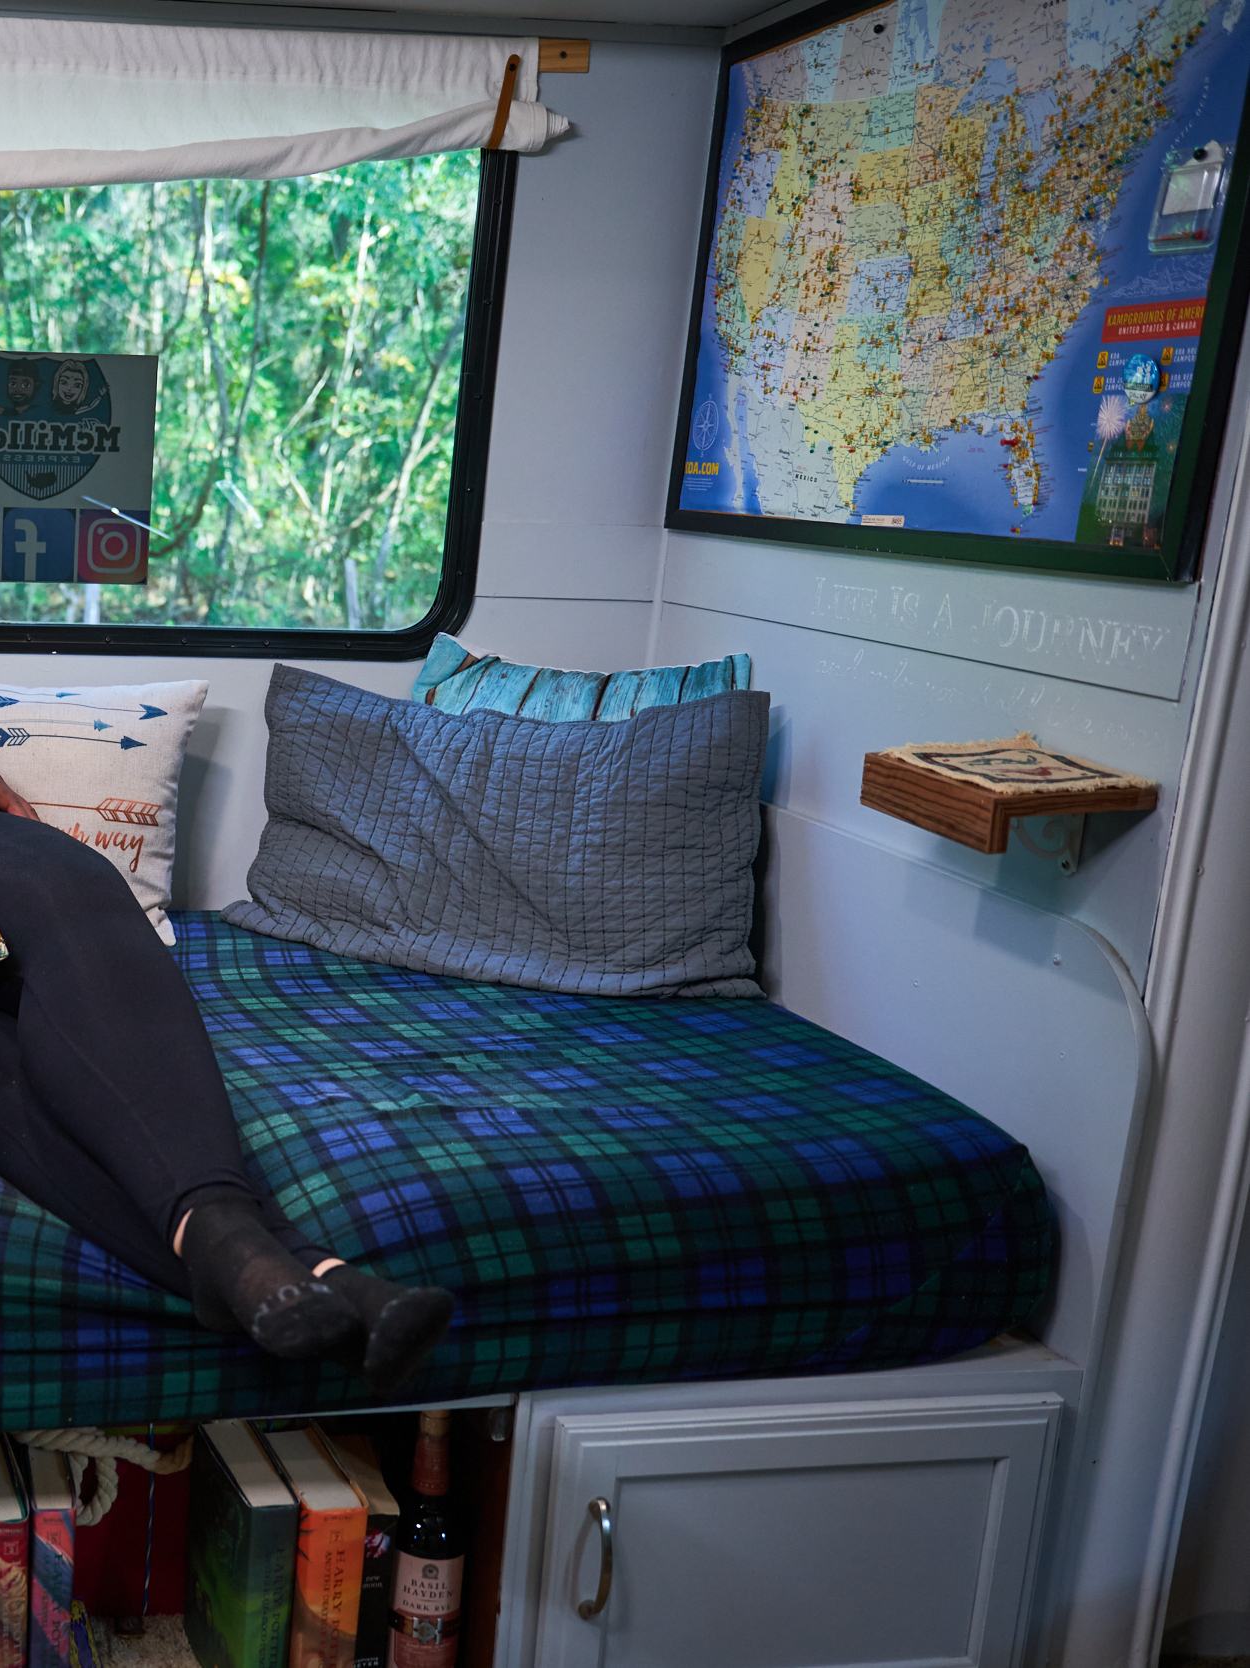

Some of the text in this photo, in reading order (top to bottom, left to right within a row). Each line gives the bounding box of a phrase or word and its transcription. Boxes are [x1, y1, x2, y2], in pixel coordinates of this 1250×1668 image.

[1107, 309, 1165, 327] KAMPGROUNDS
[1167, 308, 1177, 321] OF
[1118, 320, 1197, 335] UNITED STATES & CANADA
[684, 461, 720, 475] KOA.COM
[902, 455, 950, 471] GULF OF MEXICO
[795, 473, 818, 483] MEXICO
[95, 831, 144, 873] way
[333, 1550, 346, 1612] HARRY
[411, 1579, 448, 1590] BASIL
[403, 1585, 453, 1600] HAYDEN
[403, 1599, 451, 1612] DARK RYE
